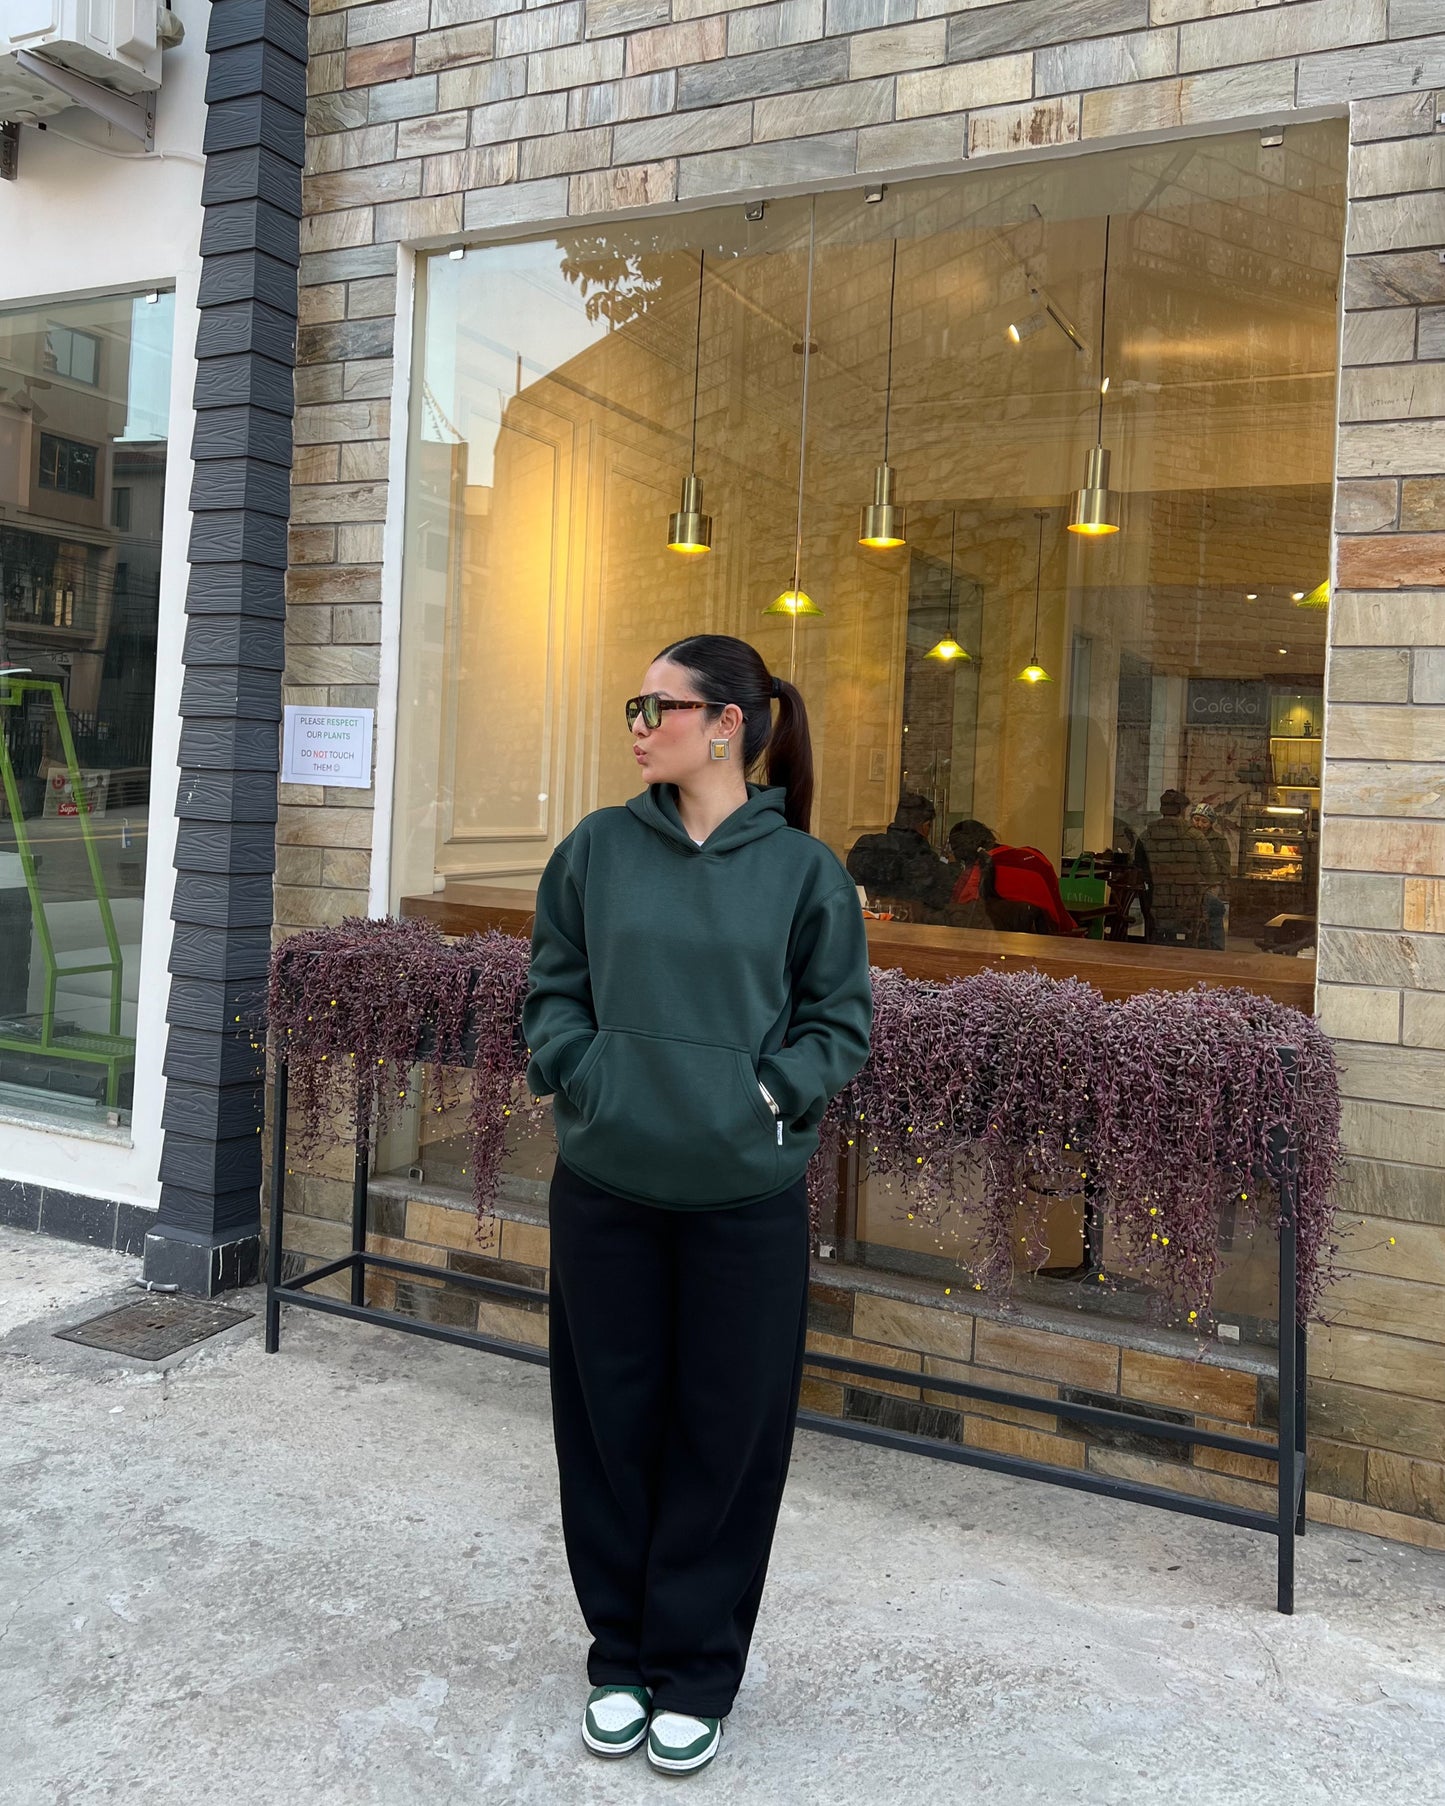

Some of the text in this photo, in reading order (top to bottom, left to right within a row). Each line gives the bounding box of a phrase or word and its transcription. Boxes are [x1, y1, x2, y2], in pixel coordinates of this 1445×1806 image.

[300, 717, 359, 727] PLEASE RESPECT
[306, 730, 351, 740] OUR PLANTS
[301, 749, 354, 759] DO NOT TOUCH
[313, 763, 332, 772] THEM
